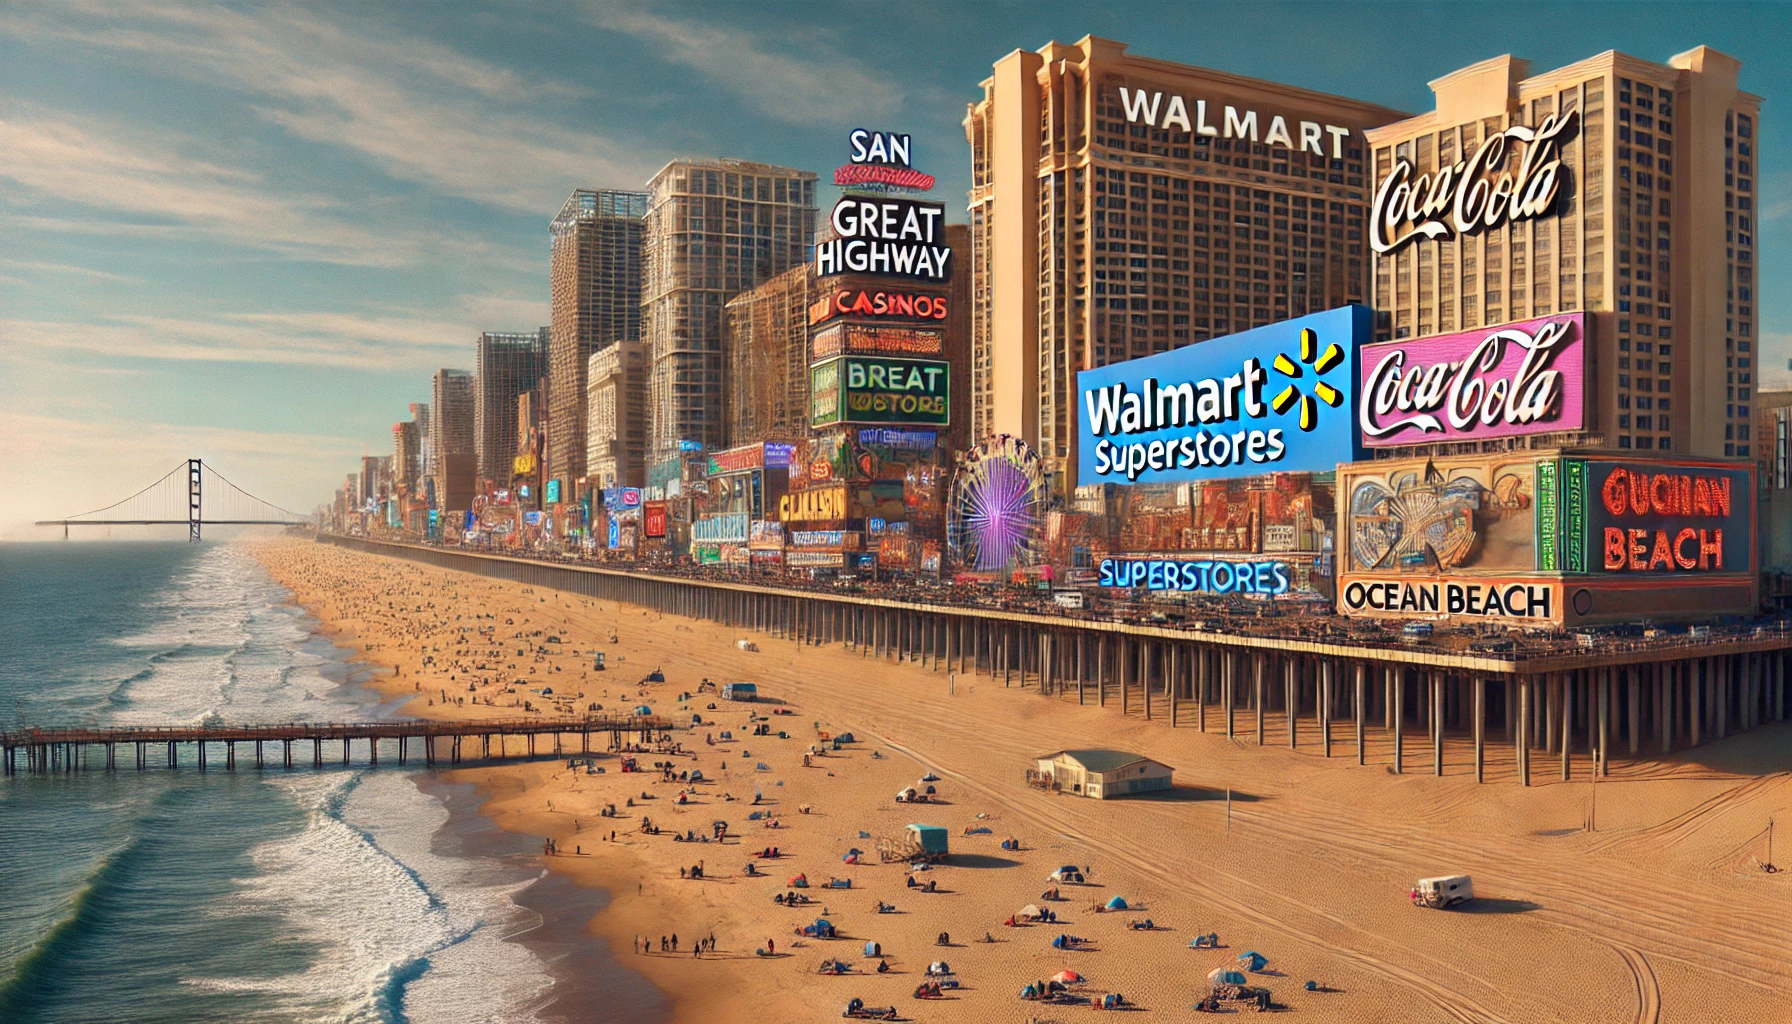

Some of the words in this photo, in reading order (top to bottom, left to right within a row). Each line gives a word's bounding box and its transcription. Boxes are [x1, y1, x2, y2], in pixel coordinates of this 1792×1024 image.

[1119, 86, 1349, 160] WALMART
[851, 129, 910, 164] SAN
[1369, 107, 1577, 253] Coca-Cola
[833, 200, 941, 242] GREAT
[817, 241, 950, 278] HIGHWAY
[835, 290, 948, 320] CASINOS
[848, 362, 944, 392] BREAT
[1085, 358, 1262, 436] Walmart
[1360, 319, 1574, 437] Coca-Cola
[1095, 428, 1285, 479] Superstores
[1603, 526, 1723, 571] BEACH
[1099, 558, 1289, 594] SUPERSTORES
[1345, 582, 1439, 611] OCEAN
[1447, 584, 1550, 618] BEACH
